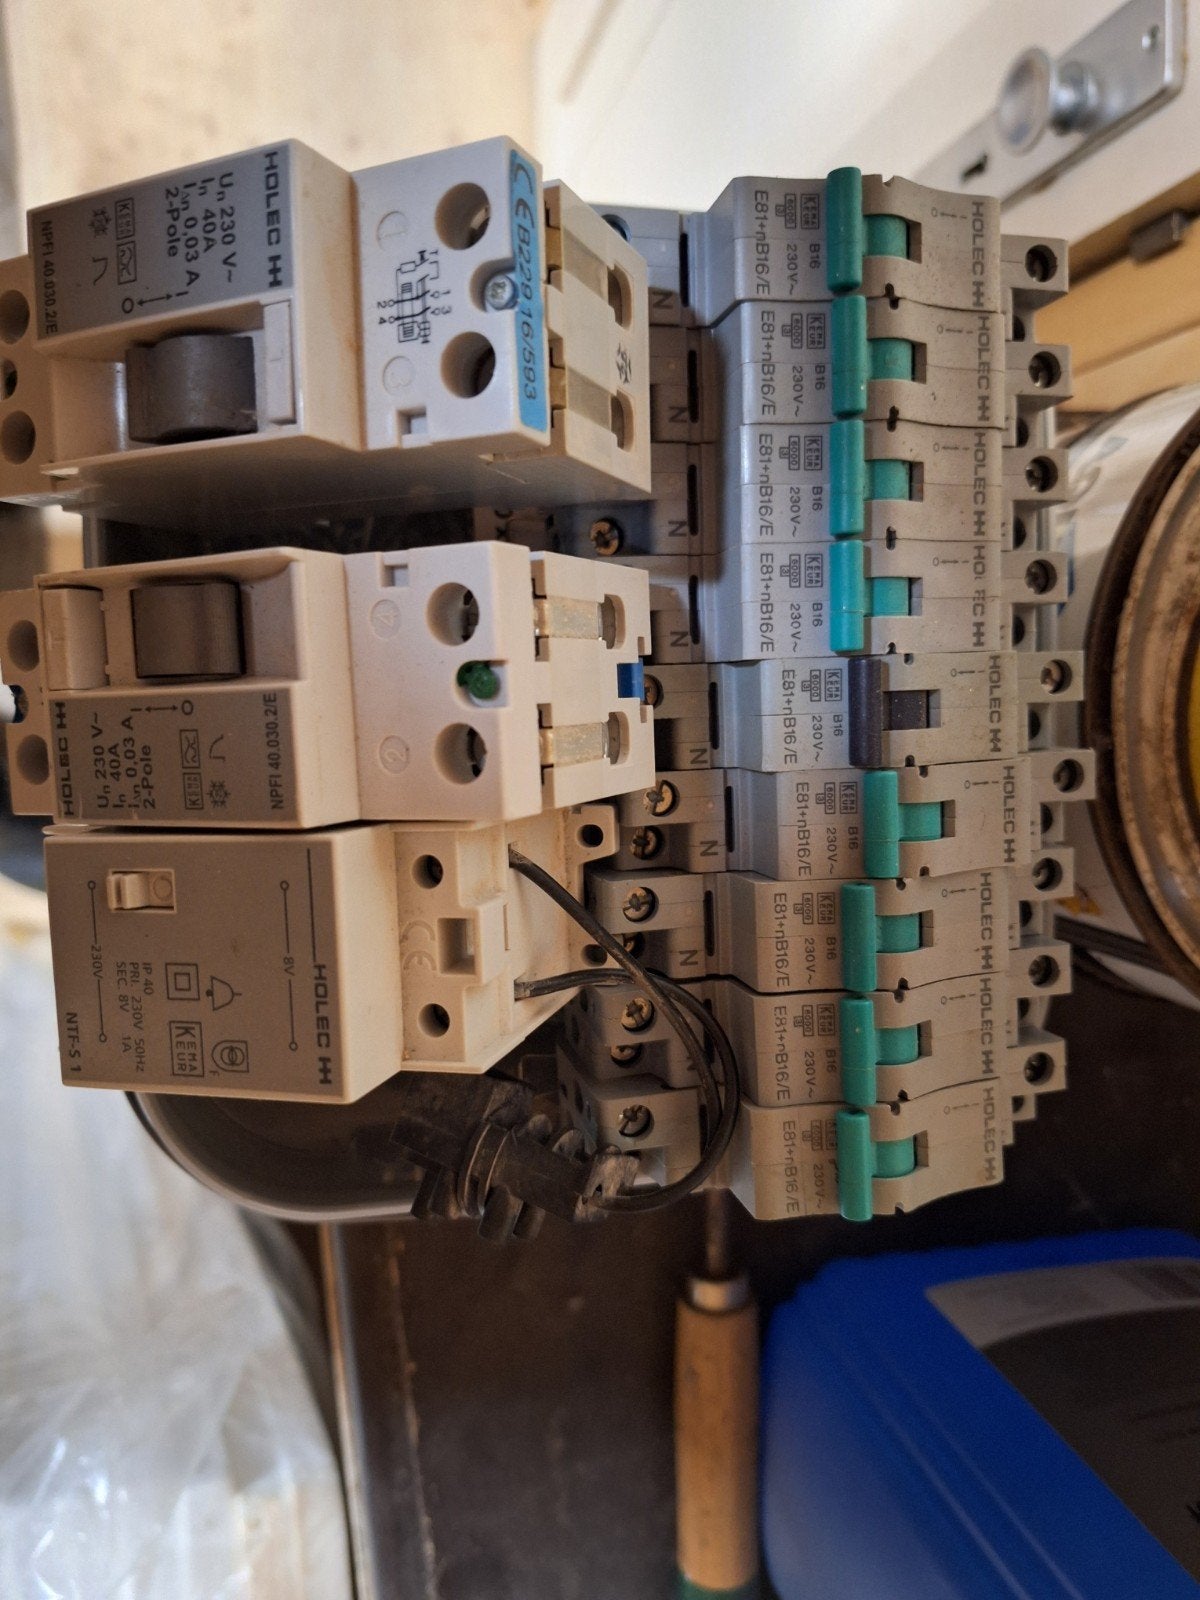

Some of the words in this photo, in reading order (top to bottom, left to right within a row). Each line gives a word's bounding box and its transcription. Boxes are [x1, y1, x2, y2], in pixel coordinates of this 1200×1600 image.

[165, 187, 182, 258] 2-Pole
[219, 206, 236, 246] 230
[264, 151, 281, 246] HOLEC
[40, 220, 54, 256] NPFI
[183, 217, 200, 262] 0,03
[202, 209, 218, 253] 40A
[754, 190, 770, 295] E81+nB16/E
[809, 243, 821, 270] B16
[971, 201, 985, 277] HOLEC
[43, 260, 57, 334] 40.030.2/E
[520, 310, 538, 401] 16/593
[760, 310, 776, 416] E81+nB16/E
[815, 364, 826, 391] B16
[977, 315, 991, 391] HOLEC
[758, 433, 774, 536] E81+nB16/E
[974, 432, 986, 506] HOLEC
[812, 486, 823, 512] B16
[668, 520, 688, 537] N
[759, 553, 775, 652] E81+nB16/E
[972, 545, 986, 617] HOEC
[670, 631, 689, 647] N
[812, 602, 823, 627] B16
[782, 669, 797, 764] E81+nB16/E
[988, 655, 1001, 724] HOLEC
[263, 693, 281, 769] 40.030.2/E
[833, 714, 843, 737] B16
[57, 737, 75, 816] HOLEC
[93, 745, 108, 780] 230
[108, 743, 121, 781] 40A
[140, 744, 156, 809] 2-Pole
[690, 748, 708, 764] N
[268, 775, 284, 810] NPFI
[1003, 766, 1015, 834] HOLEC
[701, 840, 720, 857] N
[796, 782, 811, 876] E81+nB16/E
[848, 826, 858, 850] B16
[980, 872, 993, 940] HOLEC
[91, 944, 103, 980] 230V
[283, 956, 295, 976] 8V
[679, 949, 699, 967] N
[774, 892, 790, 987] E81+nB16/E
[826, 936, 837, 960] B16
[118, 994, 129, 1012] 8V
[132, 996, 144, 1031] 230V
[313, 964, 331, 1048] HOLEC
[980, 978, 993, 1046] HOLEC
[65, 1012, 79, 1059] NTF-S
[122, 1035, 132, 1053] 1A
[134, 1039, 145, 1072] 50Hz
[774, 1006, 791, 1100] E81+nB16/E
[983, 1087, 995, 1153] HOLEC
[782, 1120, 799, 1214] E81+nB16/E
